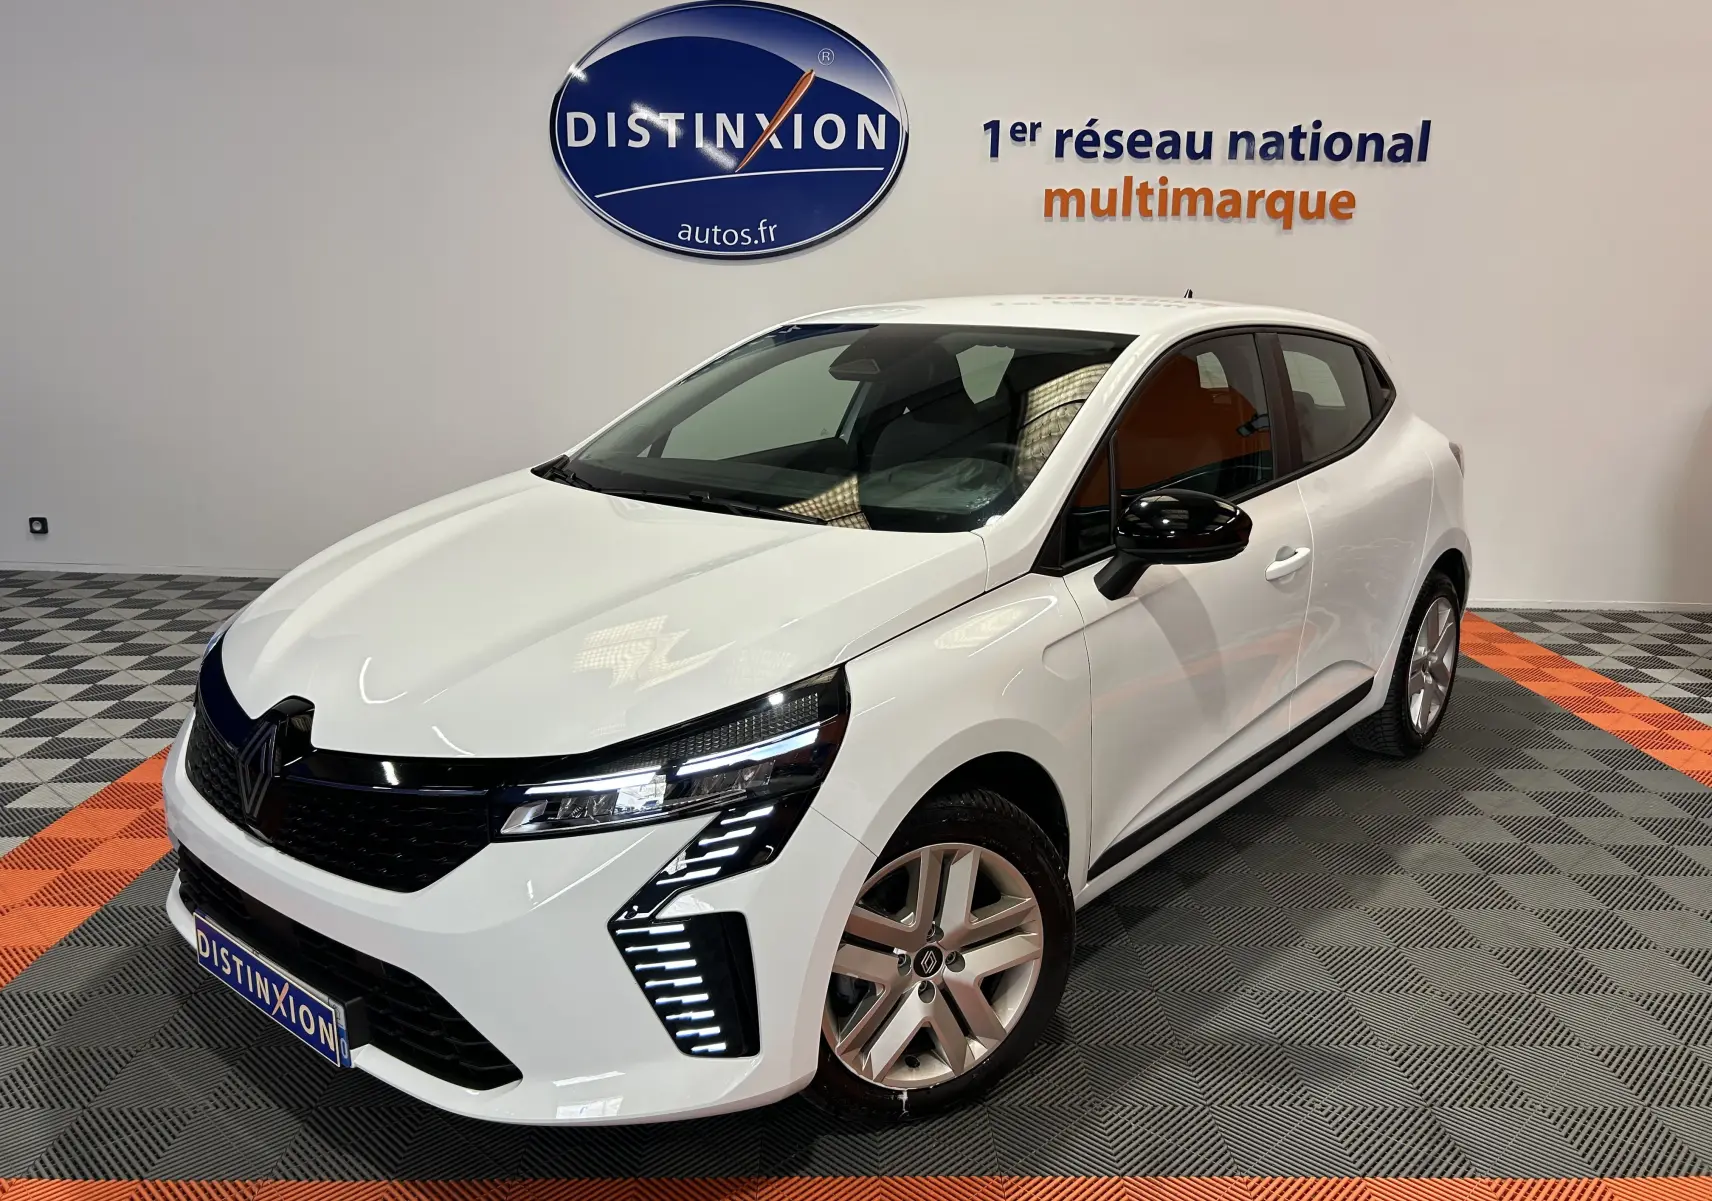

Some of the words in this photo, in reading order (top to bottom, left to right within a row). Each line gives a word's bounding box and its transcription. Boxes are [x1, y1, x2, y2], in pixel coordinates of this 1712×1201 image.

[566, 111, 886, 150] DISTINXION
[983, 119, 1042, 158] 1er
[1054, 118, 1213, 160] réseau
[1226, 119, 1432, 162] national
[1043, 175, 1356, 230] multimarque
[677, 219, 778, 246] autos.fr
[197, 929, 335, 1052] DISTINXION
